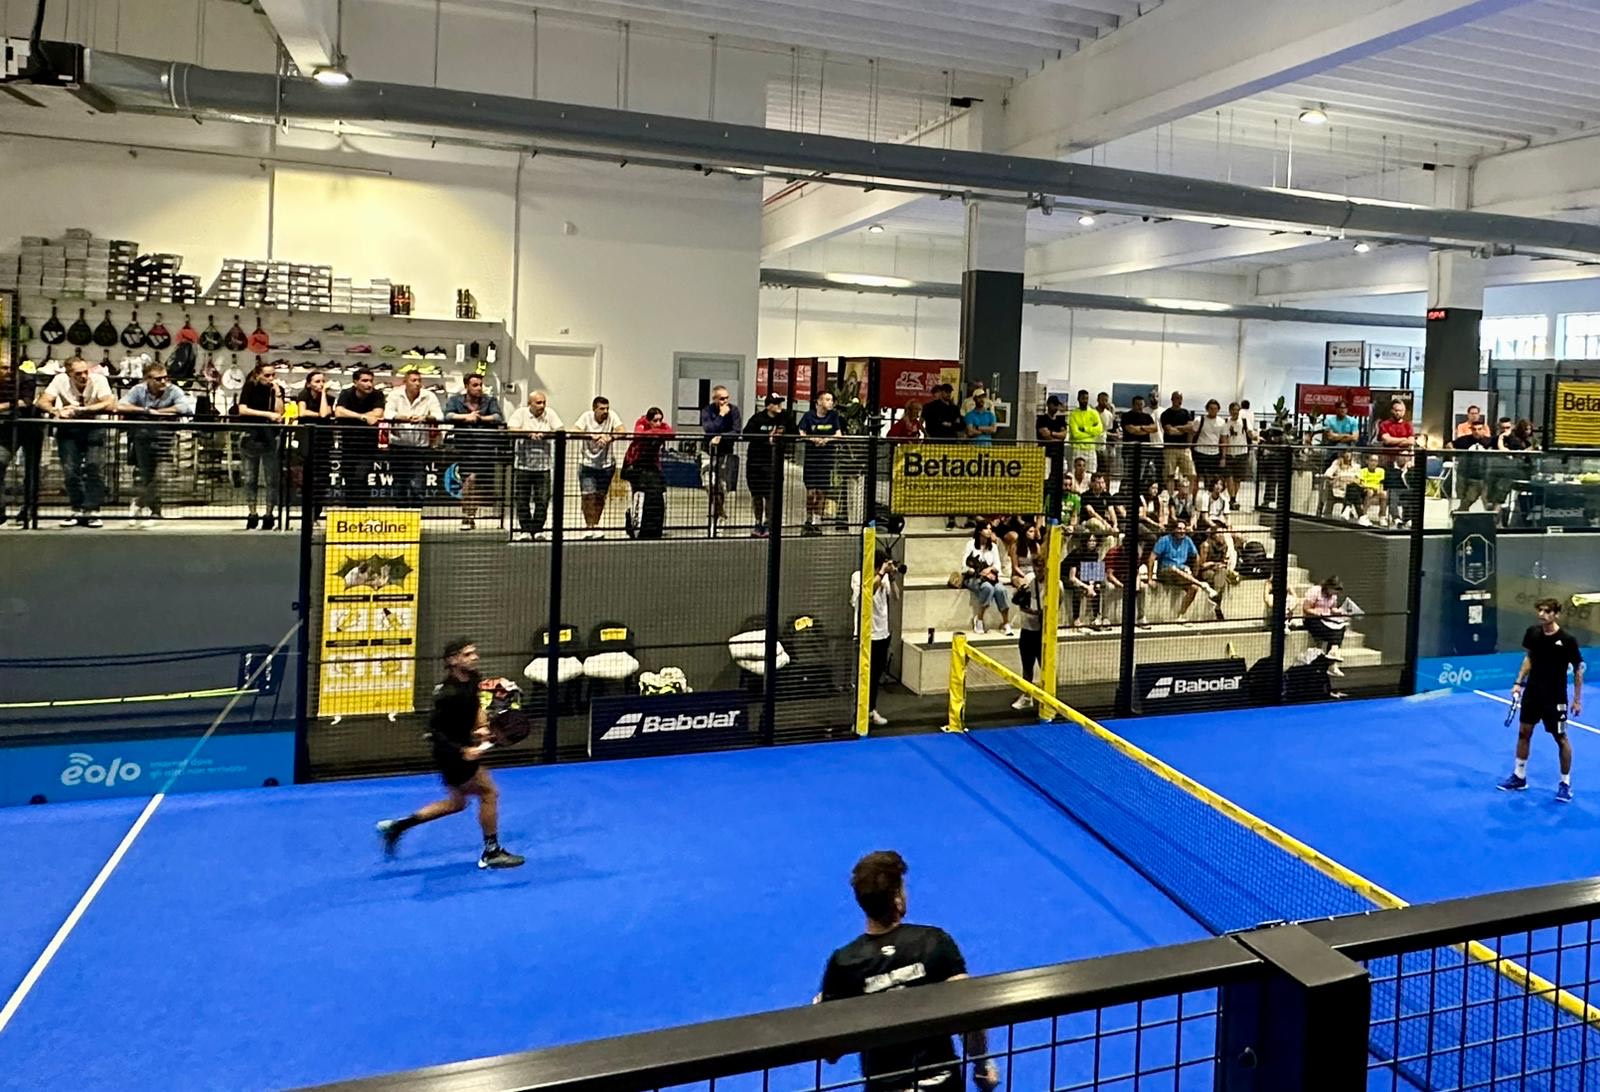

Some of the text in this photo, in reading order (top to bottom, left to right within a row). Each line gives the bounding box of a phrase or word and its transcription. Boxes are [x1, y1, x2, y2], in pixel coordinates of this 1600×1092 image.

[904, 452, 1022, 478] Betadine
[337, 521, 407, 533] Betadine
[1174, 676, 1243, 693] Babolat
[1439, 666, 1472, 685] eolo
[642, 710, 741, 733] Babolat
[61, 757, 141, 786] eolo
